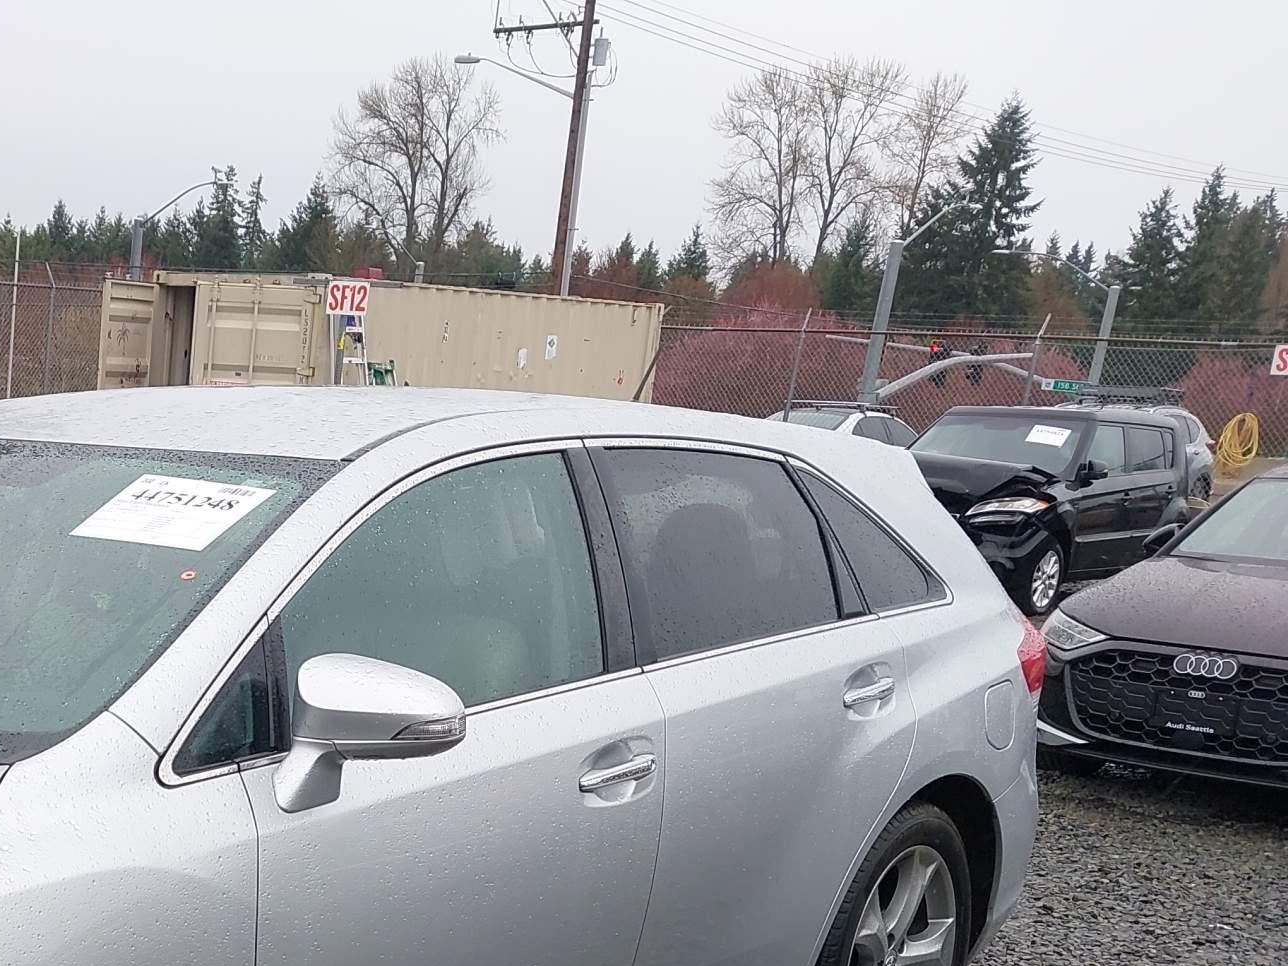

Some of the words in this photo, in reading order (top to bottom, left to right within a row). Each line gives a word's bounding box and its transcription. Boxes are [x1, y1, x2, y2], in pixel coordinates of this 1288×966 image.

[328, 283, 368, 312] SF12
[131, 489, 240, 511] 44751248
[1165, 721, 1184, 729] Audi
[1185, 724, 1214, 734] Seattle
